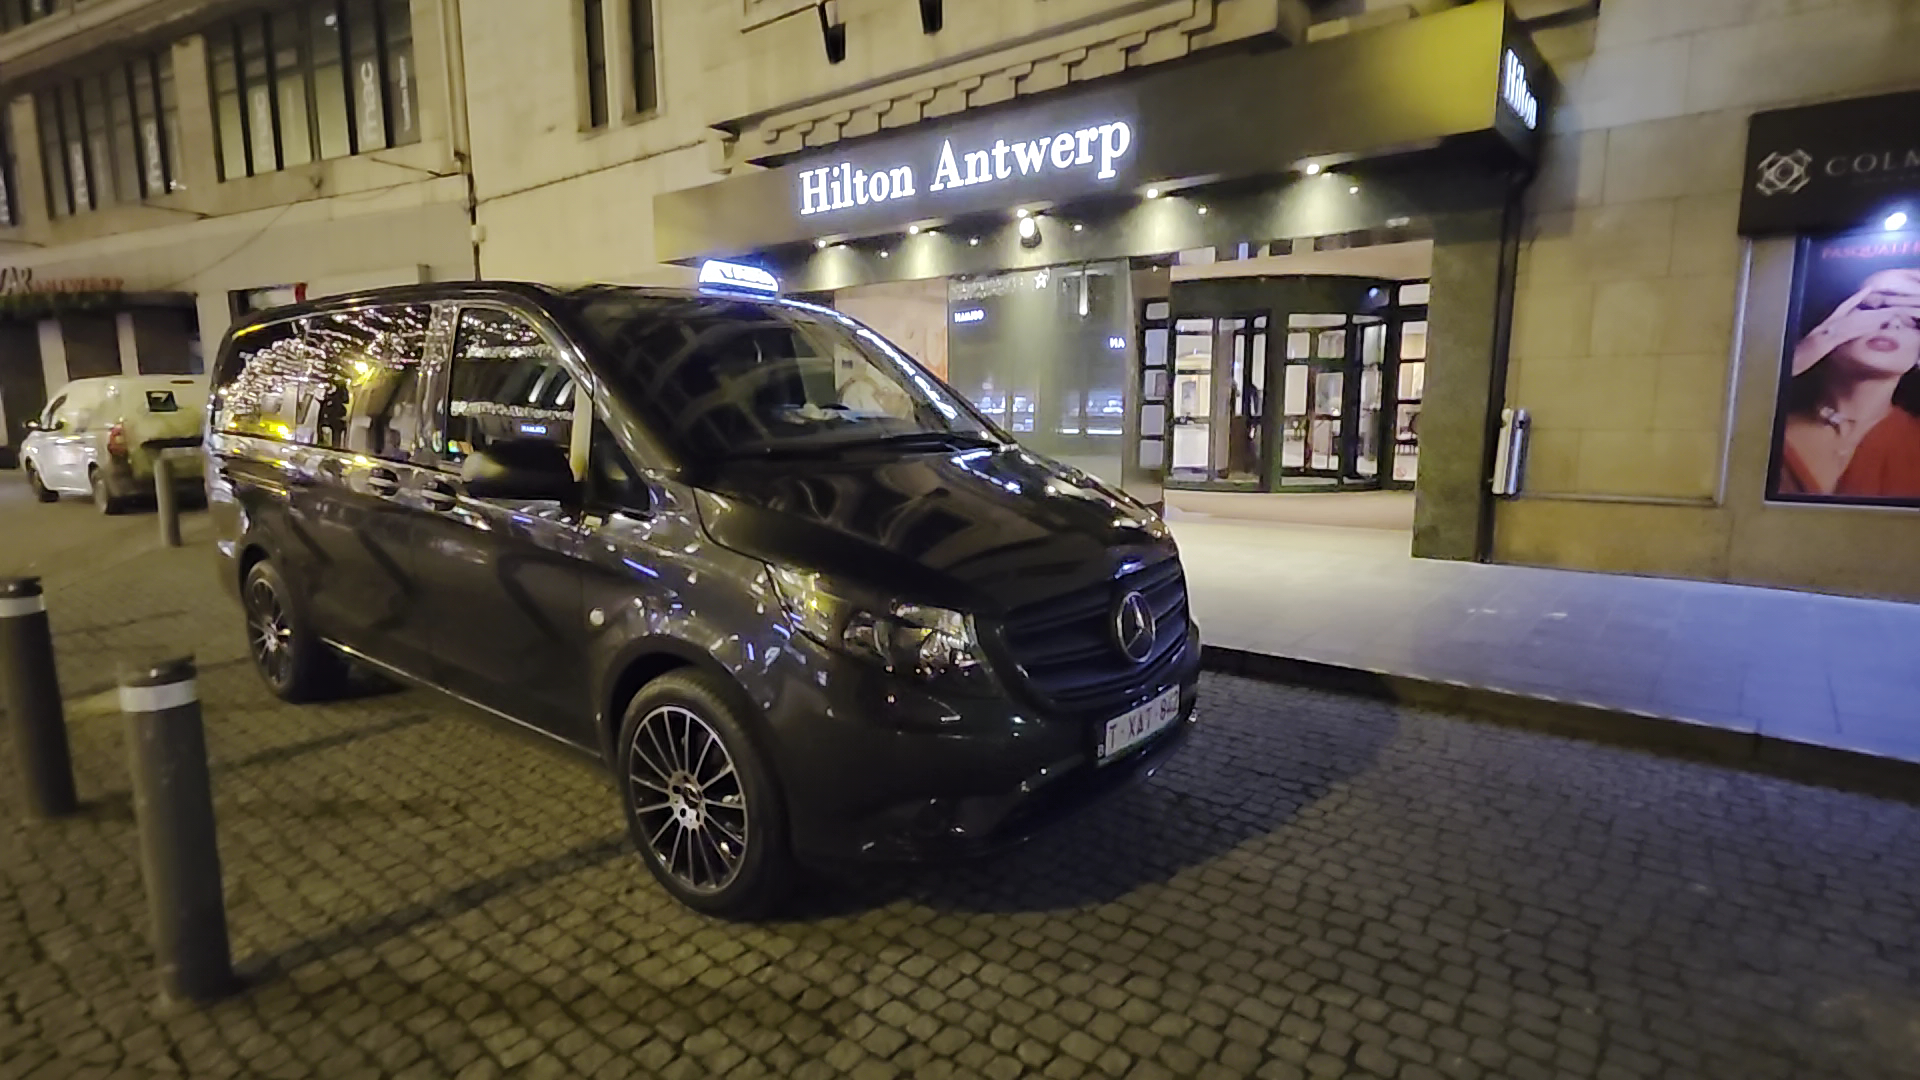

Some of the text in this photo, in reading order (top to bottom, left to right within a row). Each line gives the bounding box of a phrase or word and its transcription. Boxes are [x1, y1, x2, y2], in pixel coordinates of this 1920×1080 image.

[1503, 48, 1537, 130] Hilton
[799, 121, 1131, 215] Hilton Antwerp
